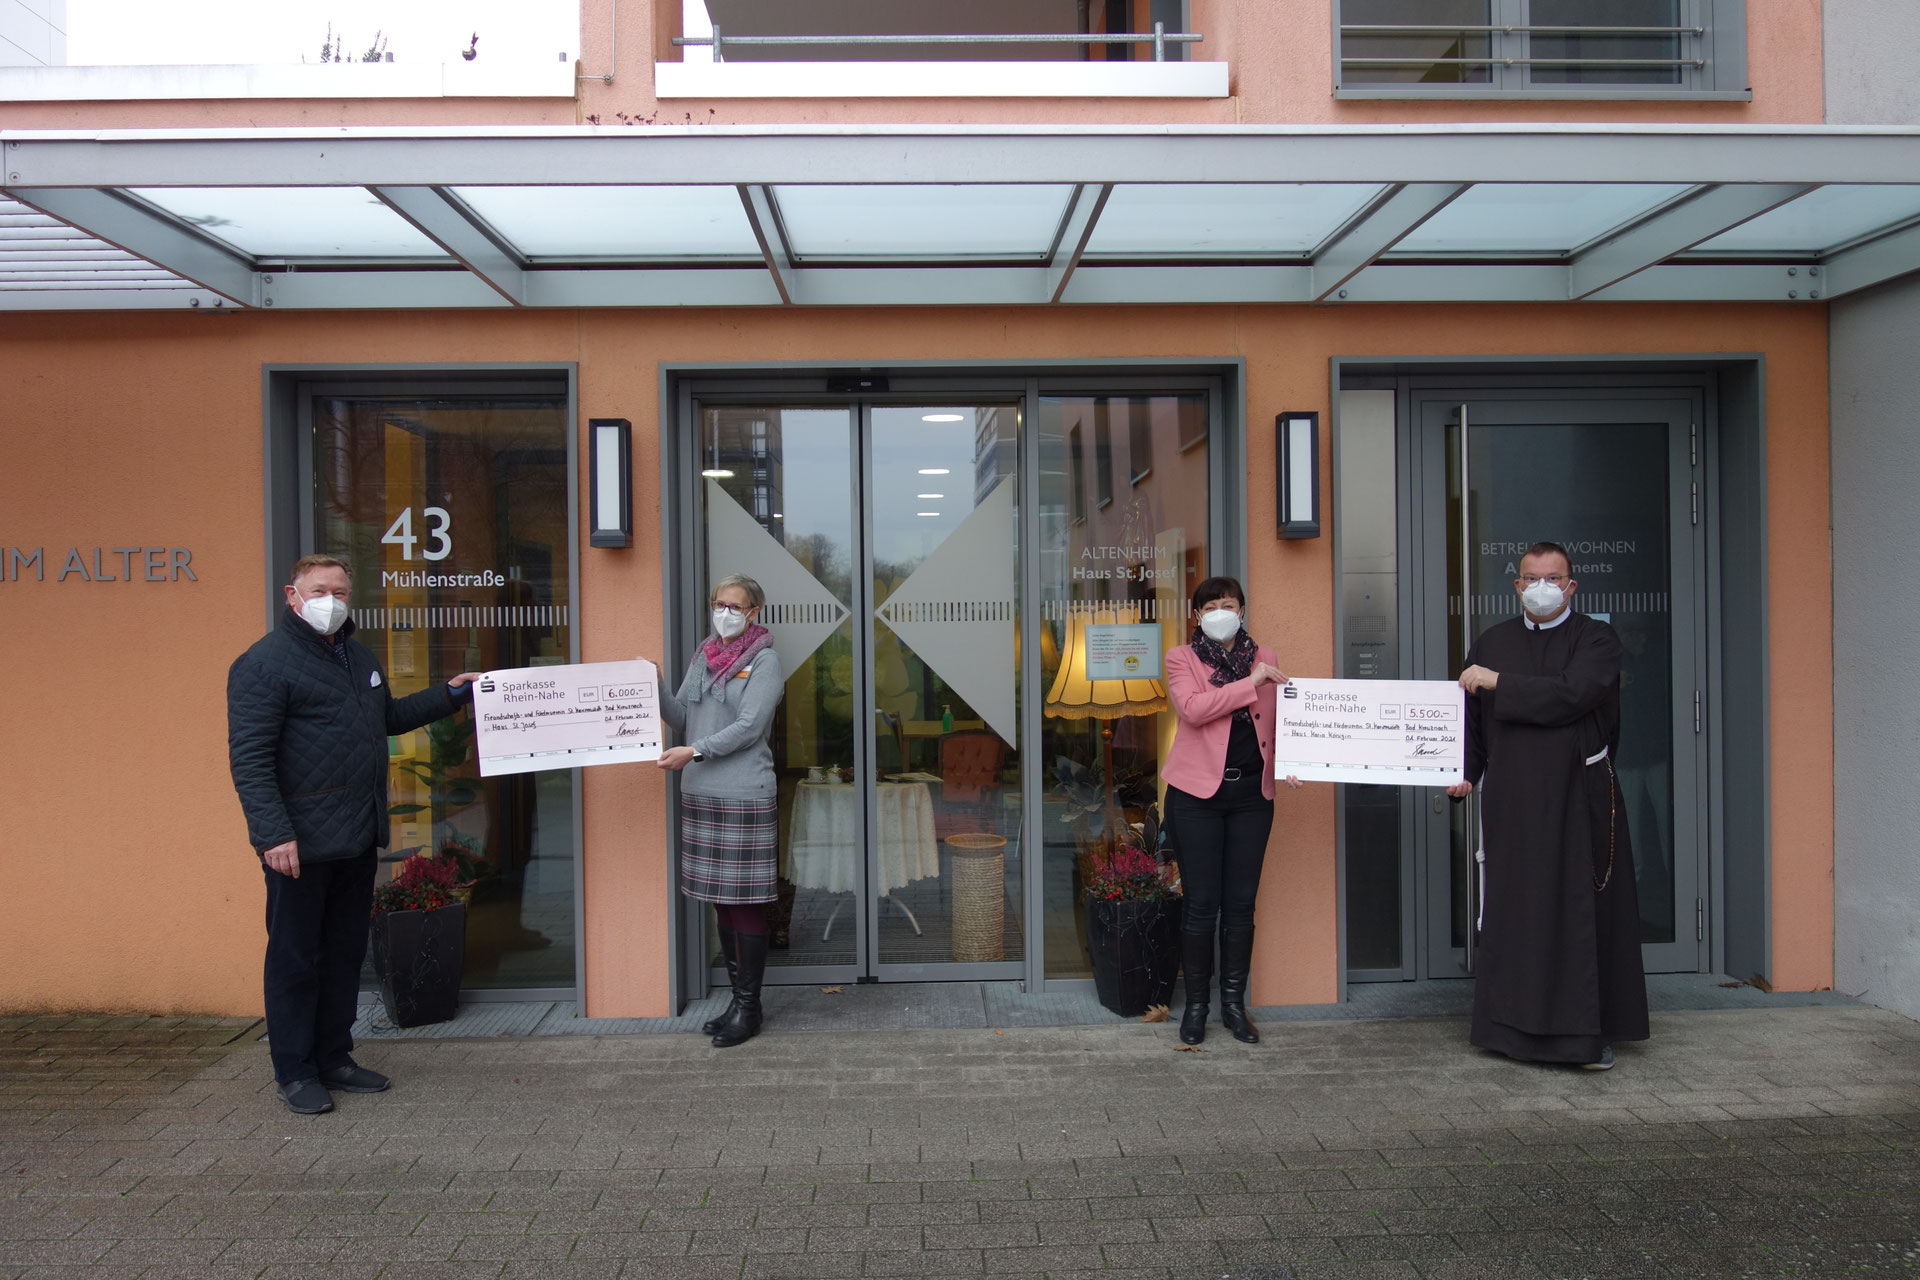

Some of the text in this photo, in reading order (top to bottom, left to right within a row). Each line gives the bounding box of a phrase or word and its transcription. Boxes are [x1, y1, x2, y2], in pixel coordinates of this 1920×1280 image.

[381, 506, 452, 561] 43
[1081, 546, 1166, 560] ALTENHEIM
[1563, 541, 1636, 554] WOHNEN
[57, 547, 198, 582] ALTER
[382, 570, 504, 588] Mühlenstraße
[1072, 566, 1177, 582] Haus St. Josef
[502, 680, 556, 694] Sparkasse
[504, 691, 565, 703] Rhein-Nahe
[1304, 691, 1358, 702] Sparkasse
[1304, 702, 1366, 713] Rhein-Nahe
